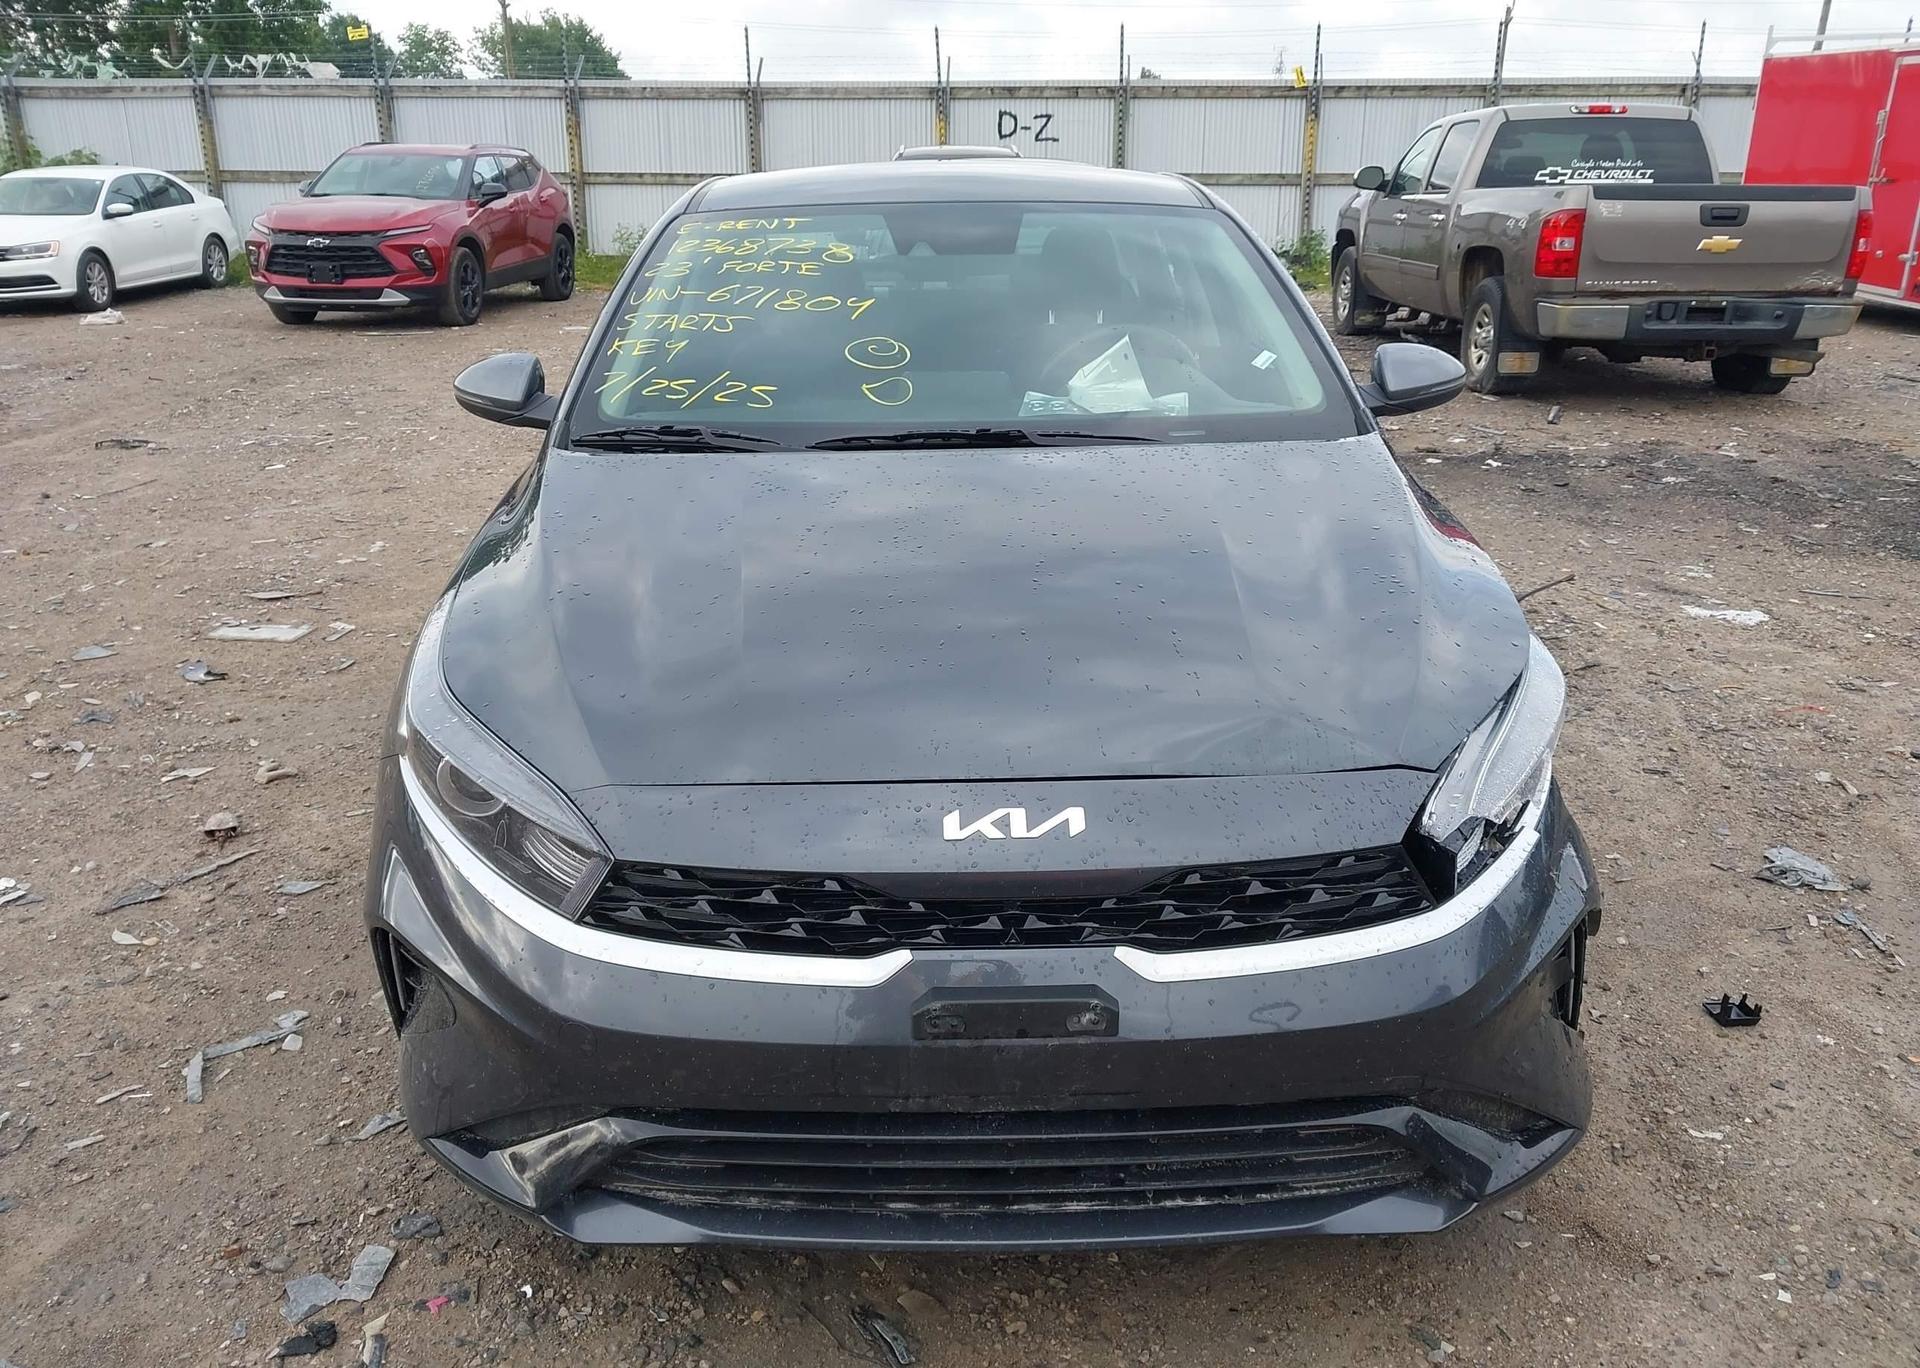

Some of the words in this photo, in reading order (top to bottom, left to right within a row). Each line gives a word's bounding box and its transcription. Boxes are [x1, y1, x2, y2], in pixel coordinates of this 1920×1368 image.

[717, 259, 825, 276] FORTE
[617, 312, 755, 333] STARTS
[606, 338, 690, 364] KEY
[594, 366, 778, 410] 7/25/25
[942, 806, 1087, 841] KIA
